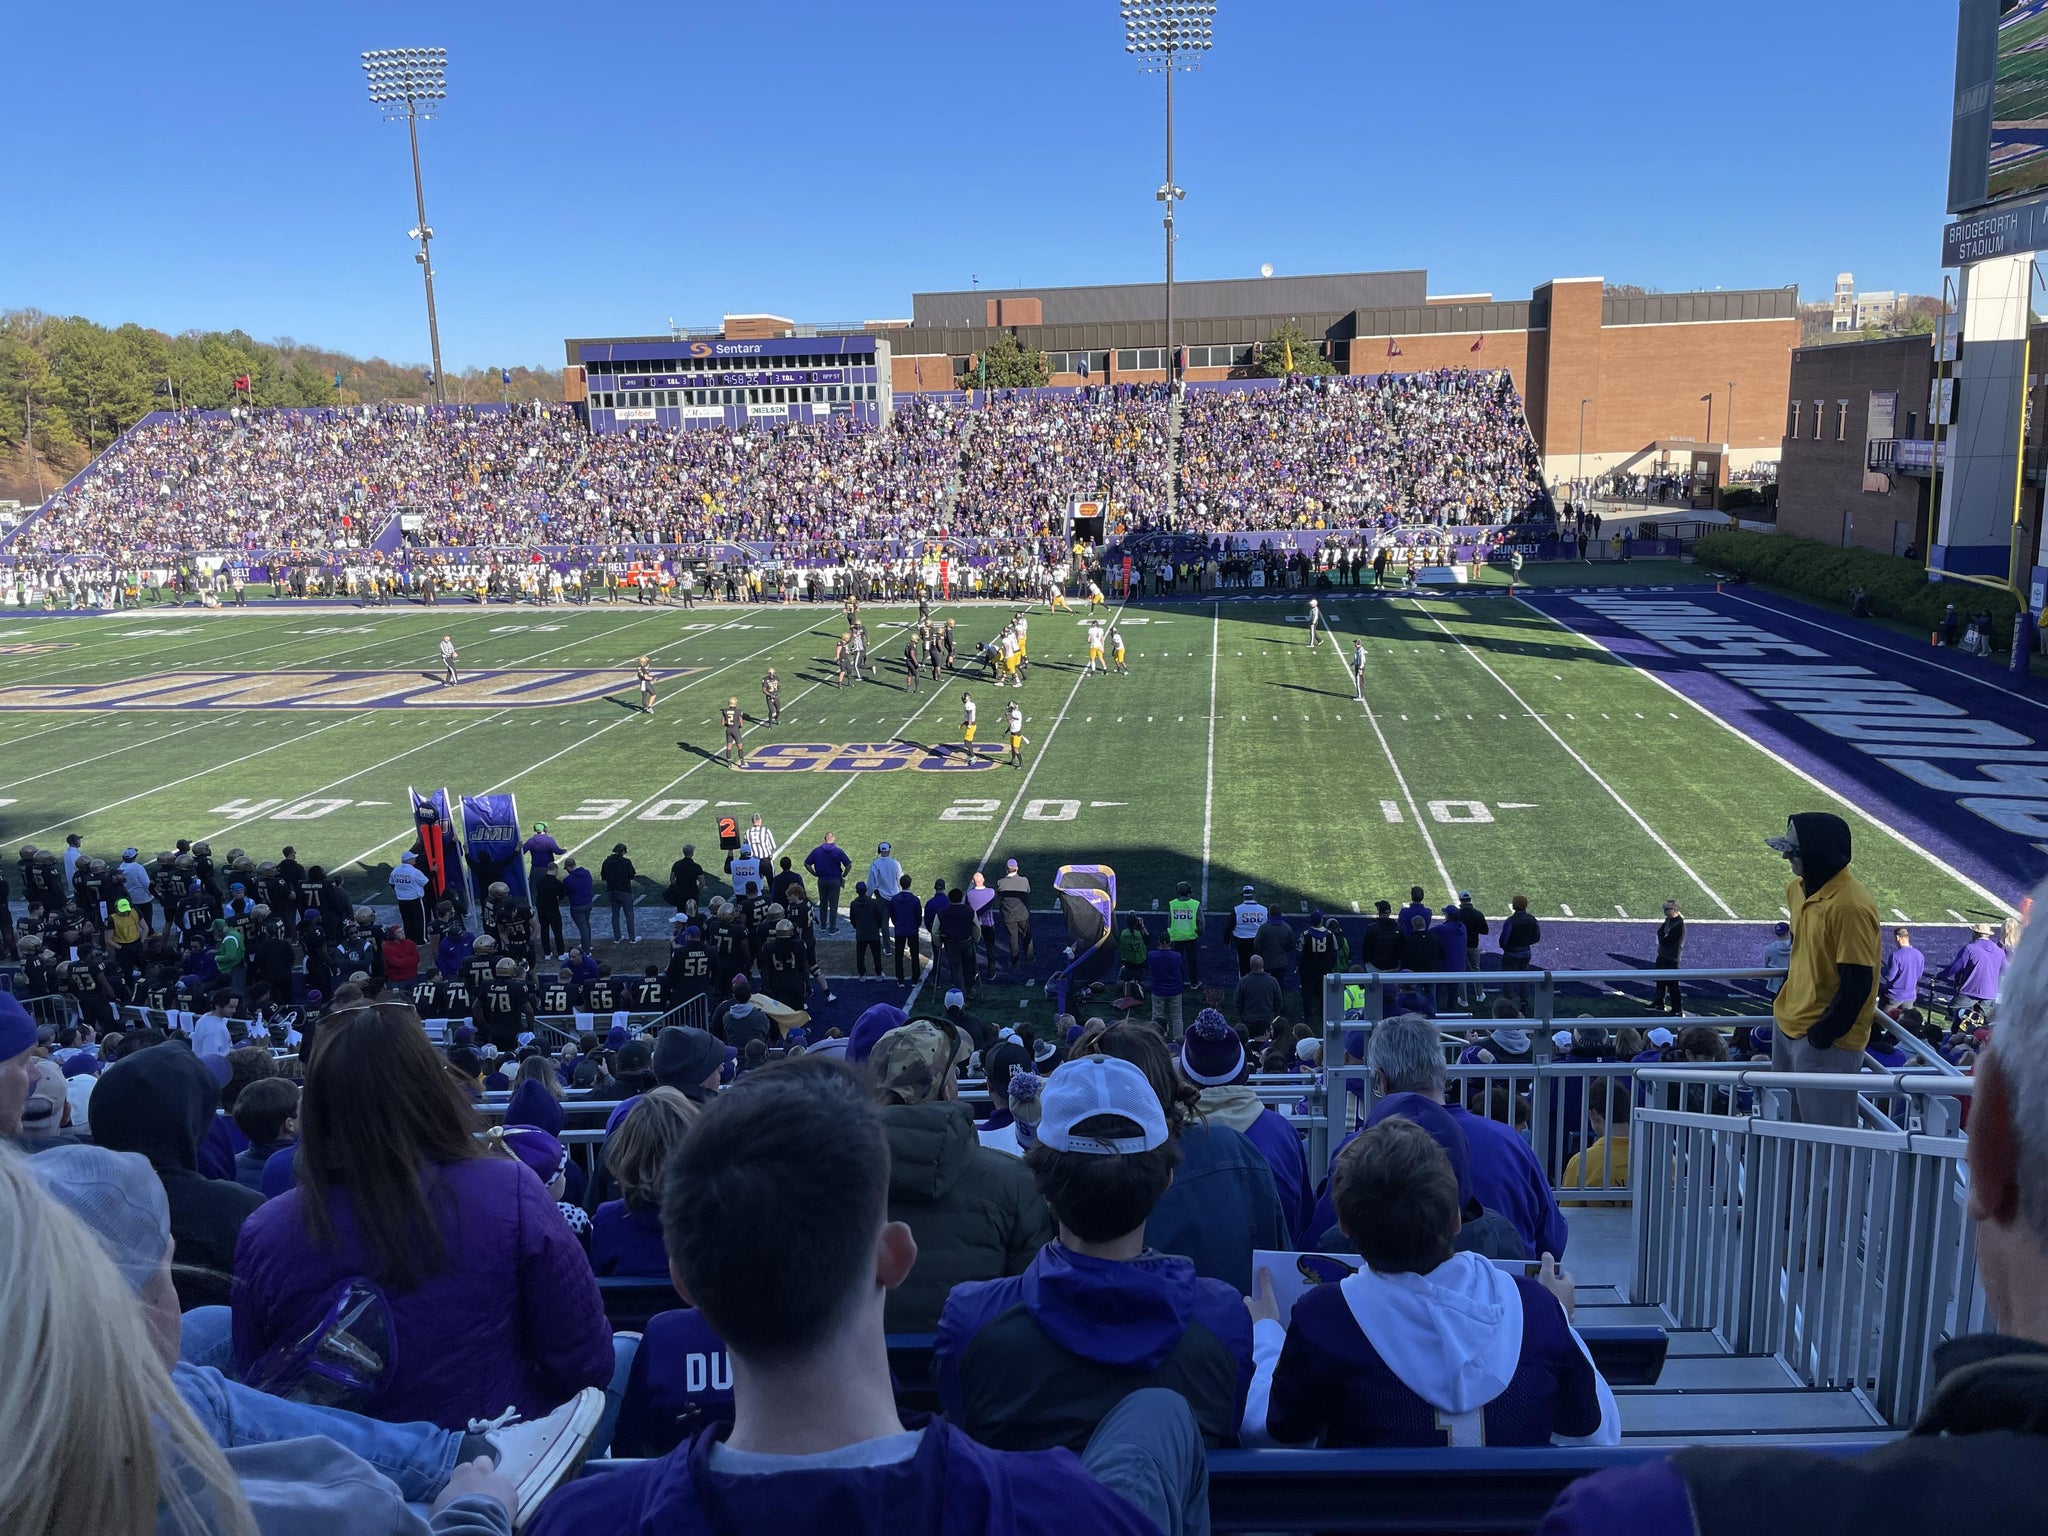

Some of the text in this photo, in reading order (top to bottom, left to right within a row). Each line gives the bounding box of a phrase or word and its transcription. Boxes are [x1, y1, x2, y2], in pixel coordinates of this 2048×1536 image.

[1949, 213, 2018, 244] BRIDGEFORTH
[1959, 236, 2004, 260] STADIUM
[716, 344, 760, 354] Sentara
[724, 375, 743, 384] 9:58
[746, 376, 759, 386] 25
[1494, 544, 1540, 555] SUN BELT
[1568, 594, 1833, 657] JAMES
[728, 714, 734, 725] 2
[206, 798, 354, 819] 40
[555, 798, 709, 820] 30
[938, 798, 1081, 820] 20
[1379, 800, 1495, 822] 10
[470, 825, 515, 842] JMU
[720, 818, 737, 838] 2
[304, 890, 321, 907] 71
[1173, 909, 1194, 920] SBC
[1242, 912, 1265, 923] SBC
[1311, 937, 1327, 953] 18
[684, 957, 708, 977] 56
[412, 985, 435, 1005] 44
[447, 989, 470, 1009] 74
[487, 992, 511, 1013] 78
[544, 991, 567, 1012] 58
[590, 989, 613, 1010] 66
[638, 983, 661, 1004] 72
